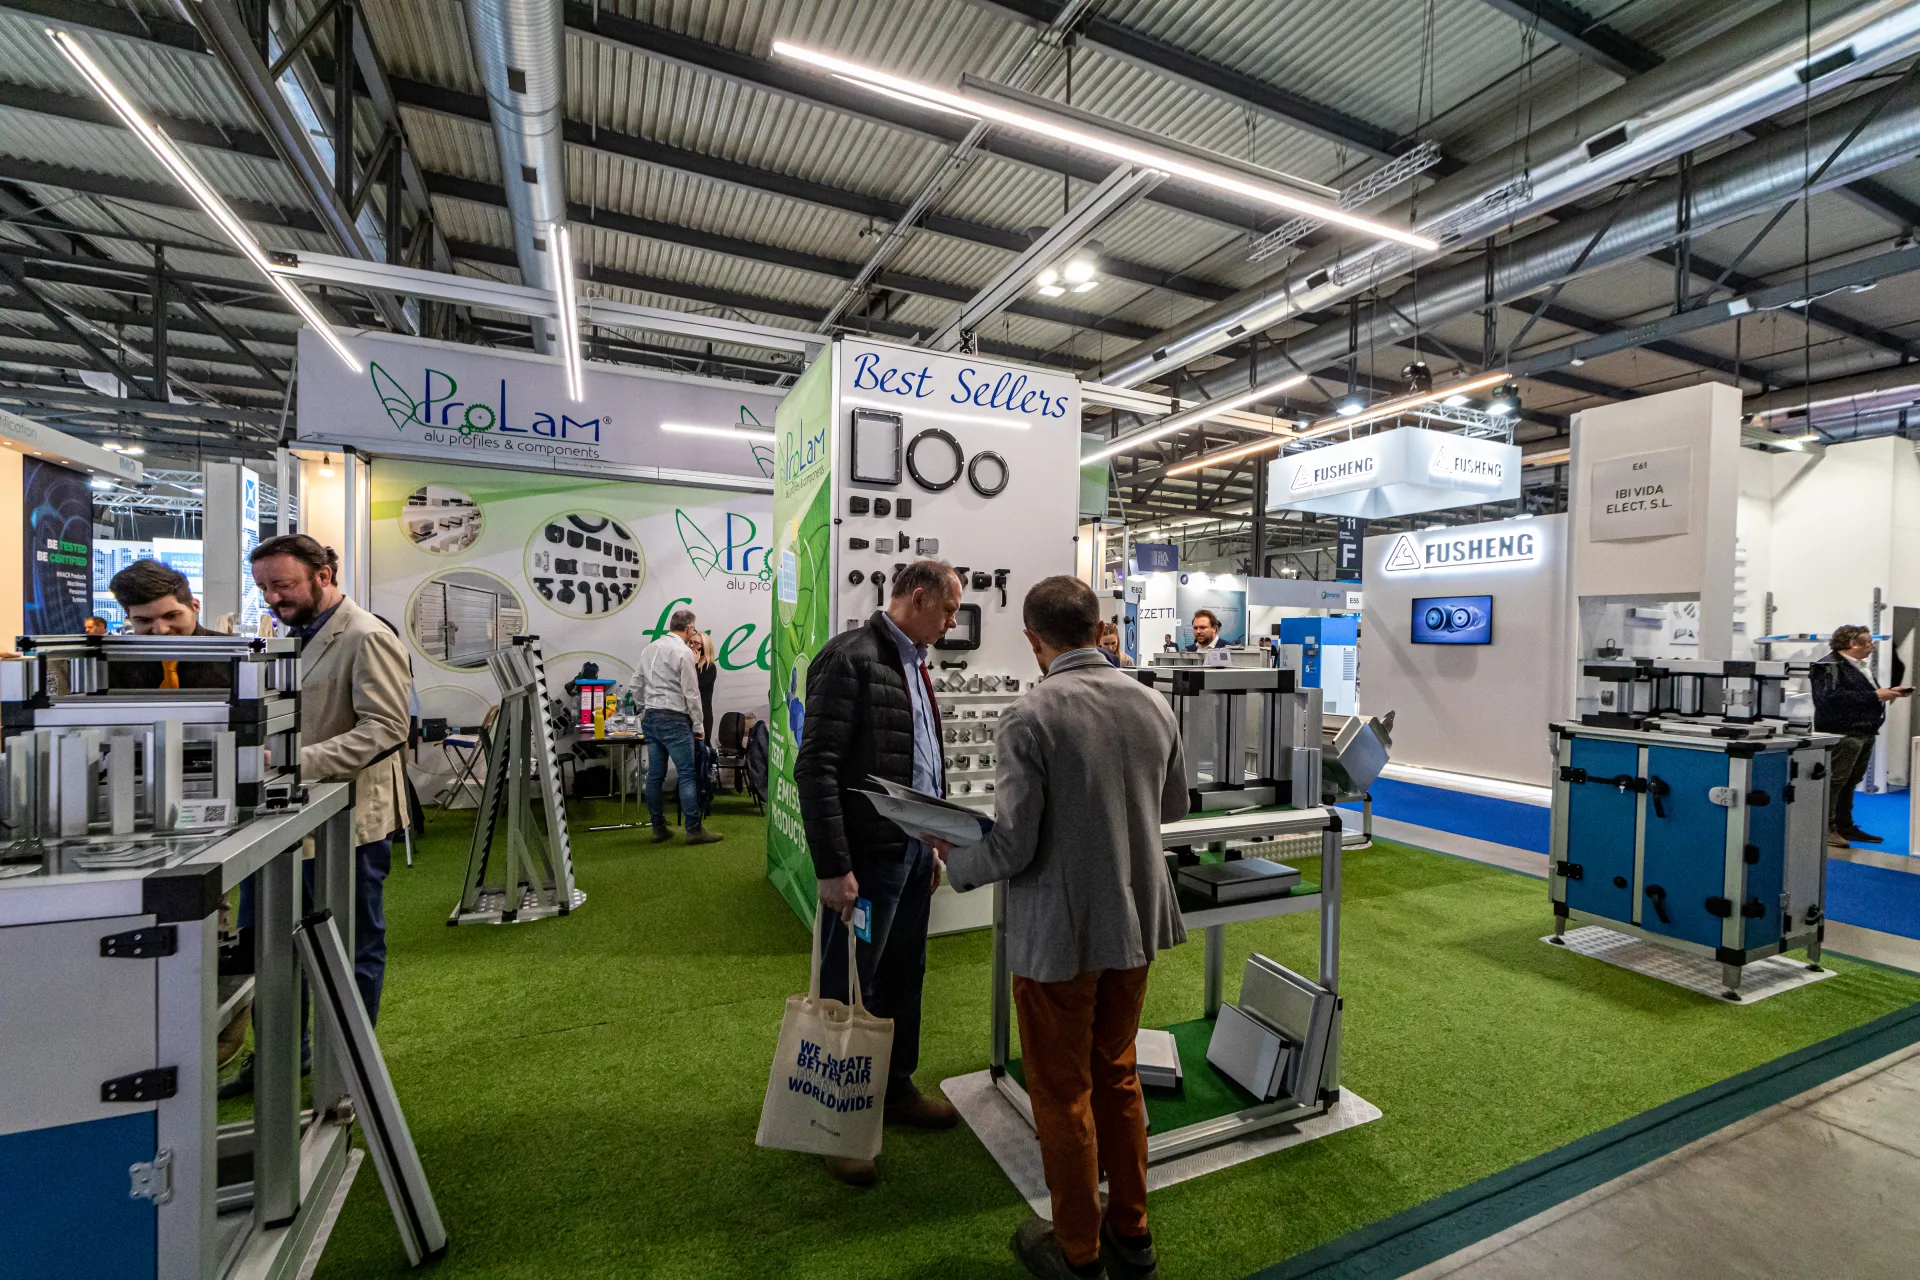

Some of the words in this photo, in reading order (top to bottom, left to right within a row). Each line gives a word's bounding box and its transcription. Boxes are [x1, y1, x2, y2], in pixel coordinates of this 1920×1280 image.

[854, 352, 934, 398] Best
[951, 368, 1069, 418] Sellers
[424, 429, 444, 443] alu
[449, 432, 500, 449] profiles
[505, 440, 514, 450] &
[517, 441, 600, 459] components
[1314, 457, 1373, 483] FUSHENG
[1454, 457, 1502, 479] FUSHENG
[1632, 461, 1647, 471] E61
[1615, 488, 1632, 499] IBI
[1634, 484, 1664, 497] VIDA
[1650, 498, 1673, 509] S.L.
[1346, 517, 1356, 530] 11
[47, 538, 58, 550] BE
[59, 540, 87, 554] TESTED
[1342, 543, 1357, 568] F
[1425, 533, 1534, 564] FUSHENG
[36, 550, 48, 562] BE
[49, 552, 87, 567] CERTIFIED
[171, 560, 203, 568] PRODU
[726, 577, 745, 591] alu
[1131, 586, 1143, 594] E62
[771, 741, 784, 772] ZERO
[771, 800, 806, 855] PRODUCTS
[800, 1039, 822, 1060] WE
[797, 1052, 841, 1087] BETTER
[844, 1070, 871, 1087] AIR
[788, 1076, 874, 1113] WORLDWIDE
